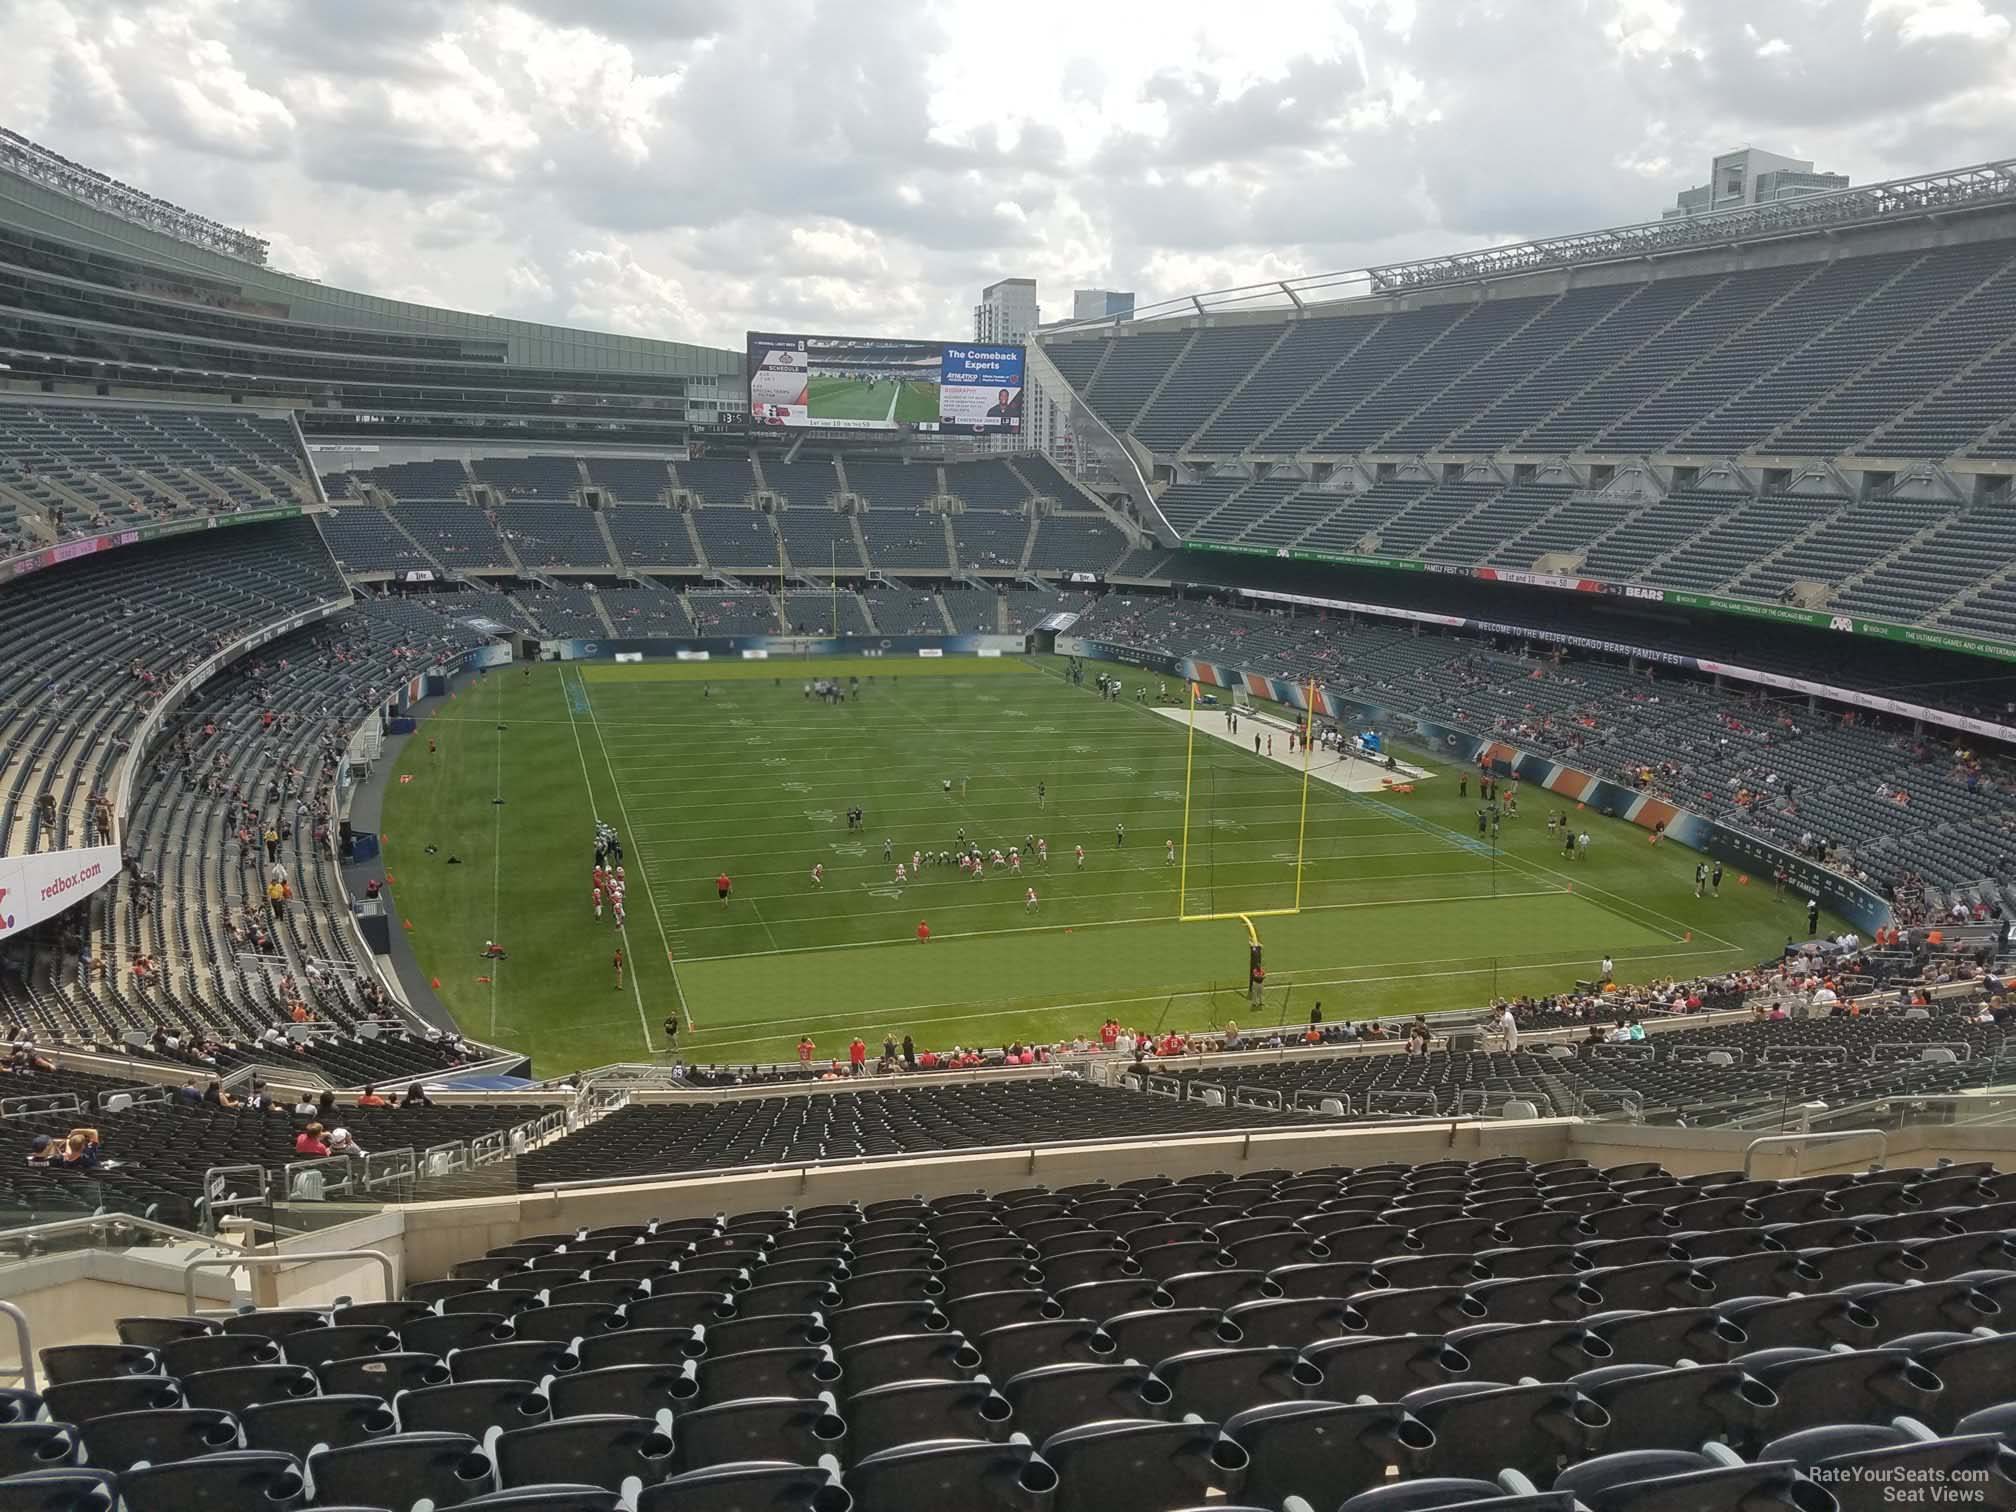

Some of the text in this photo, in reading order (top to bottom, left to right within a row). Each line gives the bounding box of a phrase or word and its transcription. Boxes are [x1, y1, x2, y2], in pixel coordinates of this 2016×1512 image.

[948, 350, 1017, 360] The Comeback
[965, 361, 1000, 370] Experts
[1625, 587, 1664, 601] BEARS
[1478, 621, 1683, 664] WELCOME TO THE MEIJER CHICAGO BEARS FAMILY FEST
[1915, 632, 1942, 644] ULTIMATE
[1942, 638, 1962, 648] GAMES
[1963, 642, 1976, 650] AND
[40, 863, 102, 901] redbox.com
[247, 1096, 261, 1108] 34
